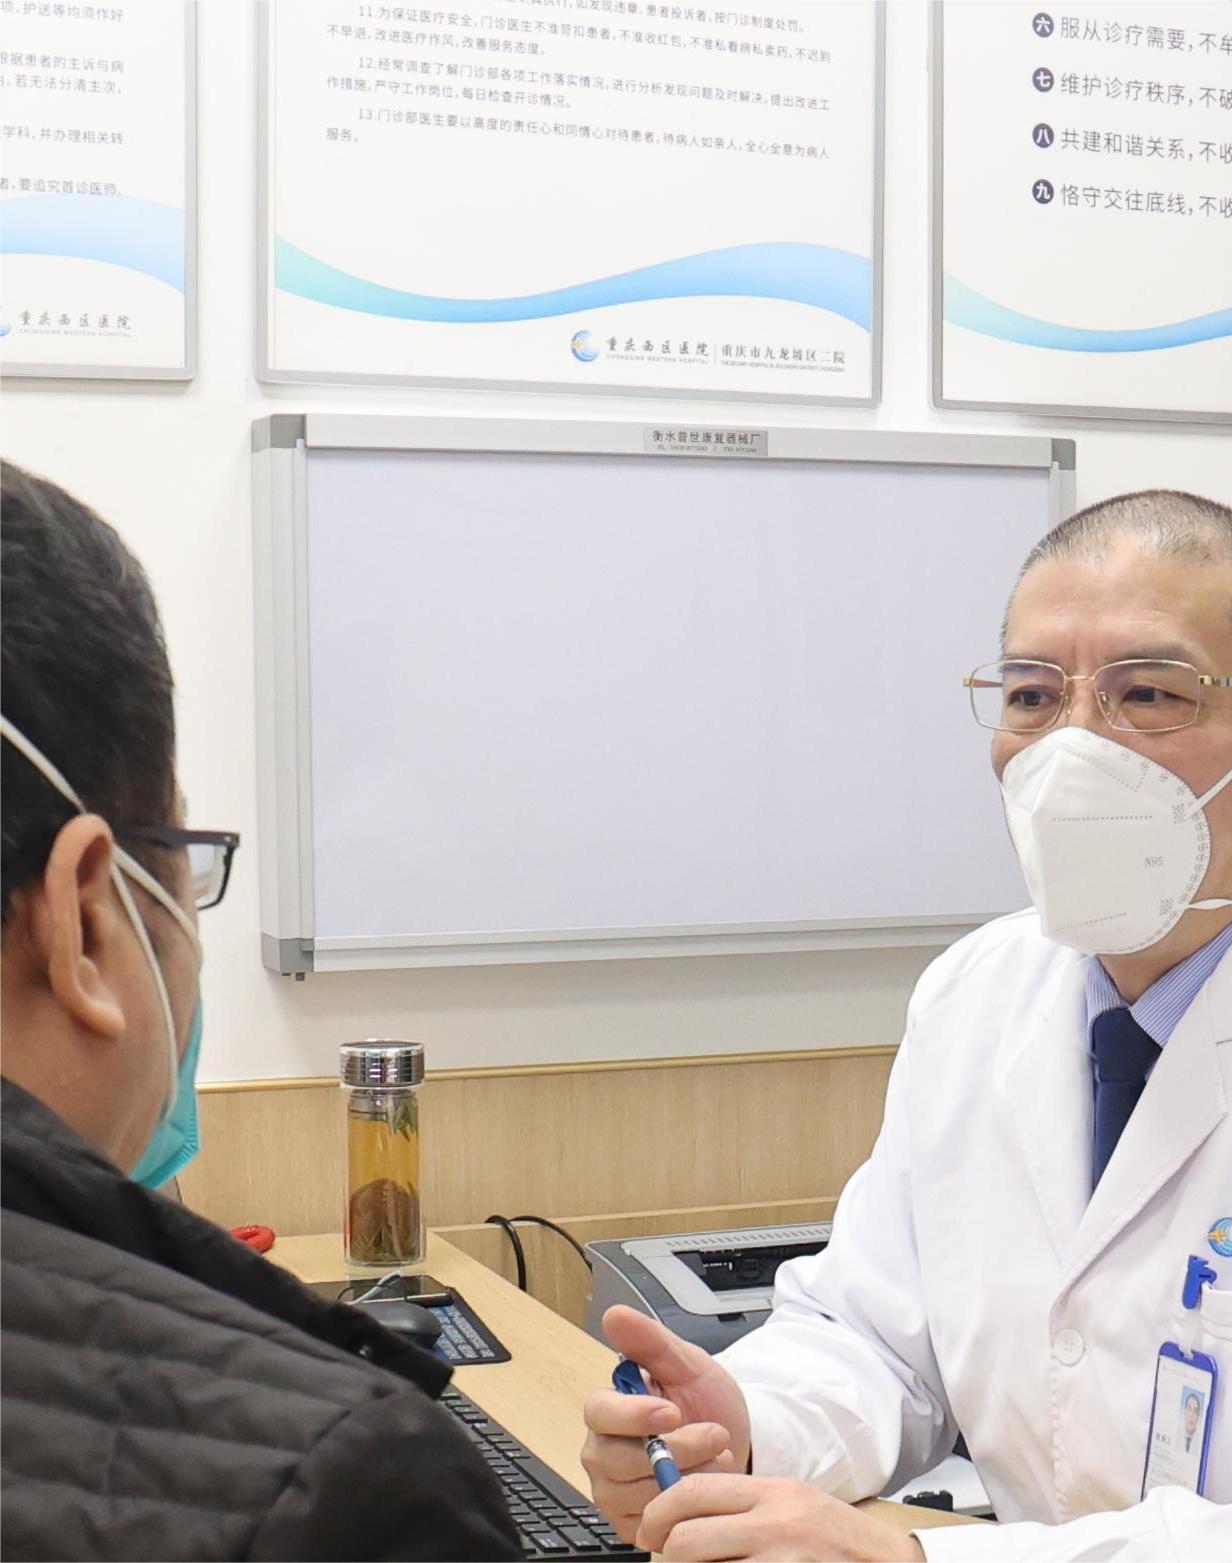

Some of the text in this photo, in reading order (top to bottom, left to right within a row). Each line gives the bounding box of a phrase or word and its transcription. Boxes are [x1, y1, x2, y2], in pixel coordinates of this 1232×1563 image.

[1034, 15, 1052, 34] 六
[1034, 70, 1052, 89] 七
[1034, 126, 1052, 145] 八
[1034, 182, 1052, 201] 九
[606, 336, 710, 357] 重庆西区医院
[721, 343, 845, 364] 重庆市九龙坡区二院
[1144, 856, 1164, 868] N95
